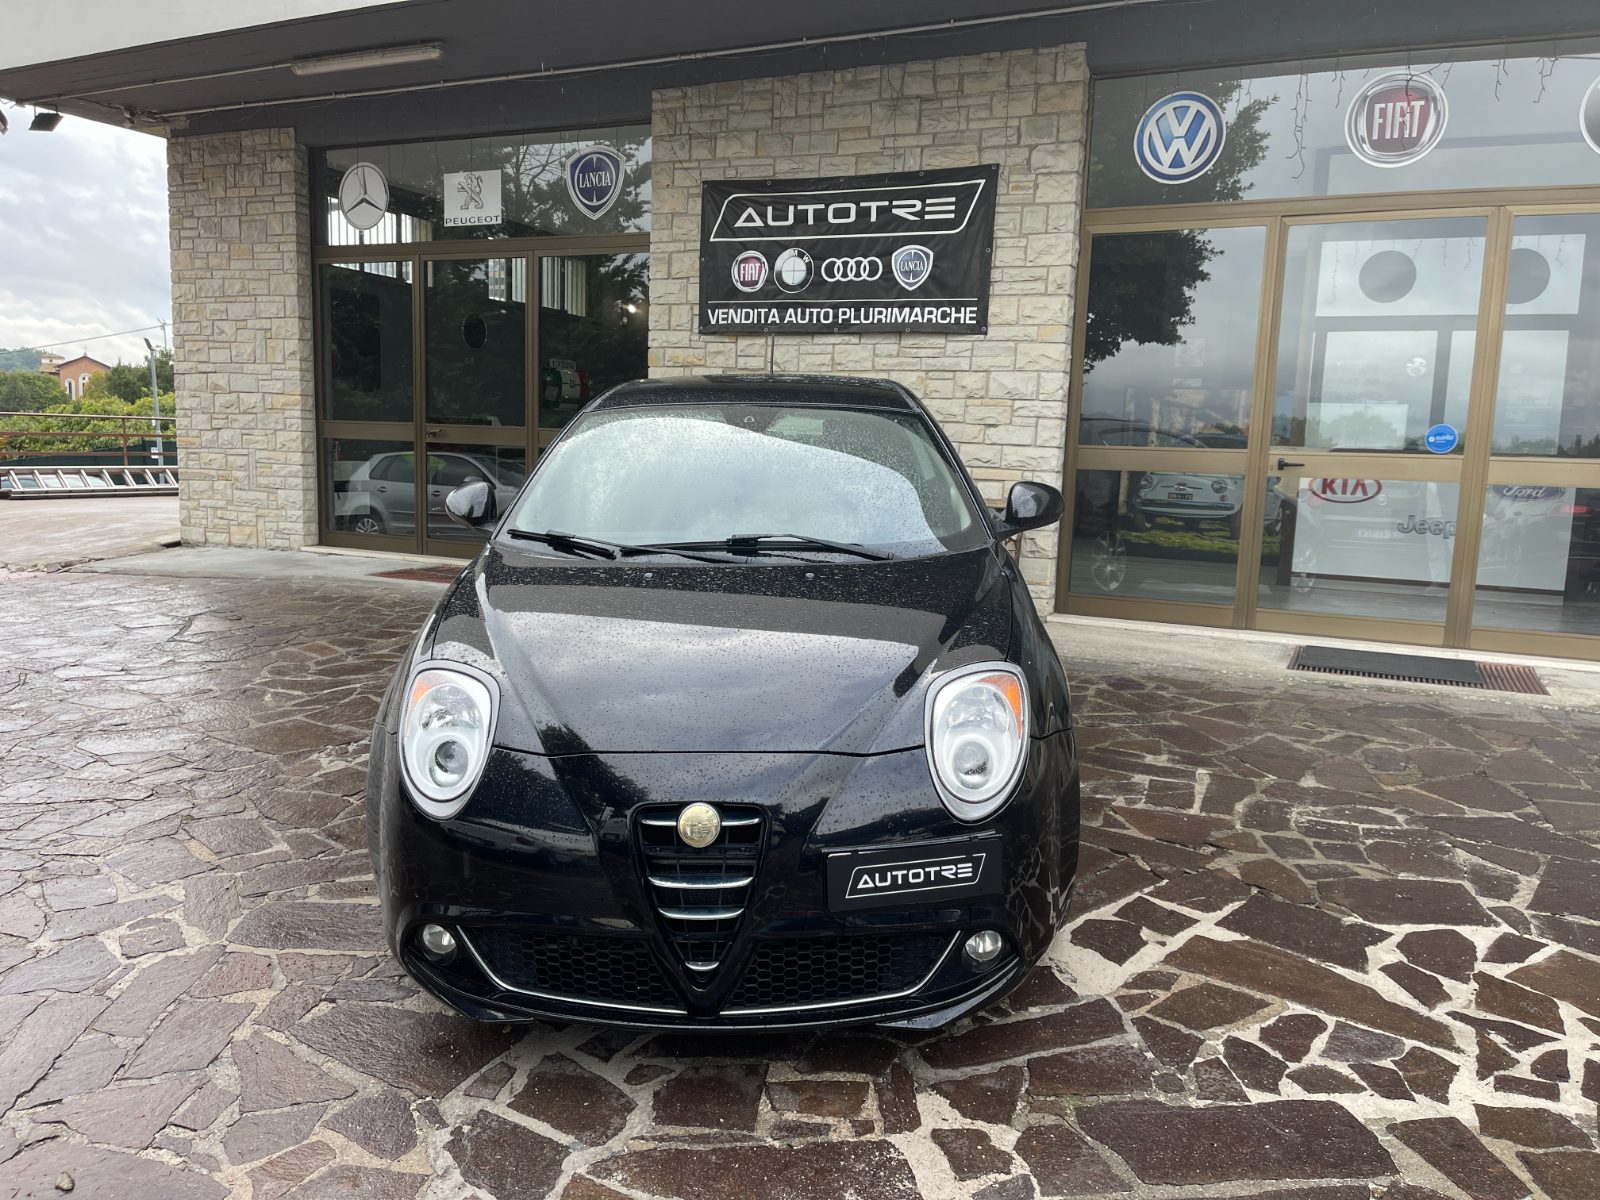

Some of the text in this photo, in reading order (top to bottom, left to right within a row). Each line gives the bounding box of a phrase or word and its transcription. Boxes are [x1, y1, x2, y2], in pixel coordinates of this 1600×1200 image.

[1371, 100, 1426, 141] FIAT
[578, 170, 612, 189] LANCIA
[445, 215, 501, 225] PEUGEOT
[733, 196, 957, 228] AUTOTRE
[740, 263, 761, 282] FIAT
[900, 260, 924, 272] LANCIA
[707, 306, 978, 325] VENDITA AUTO PLURIMARCHE
[1321, 477, 1369, 497] KIA
[1502, 485, 1547, 498] Ford
[1397, 514, 1457, 540] Jeep
[857, 863, 973, 889] AUTOTRE
